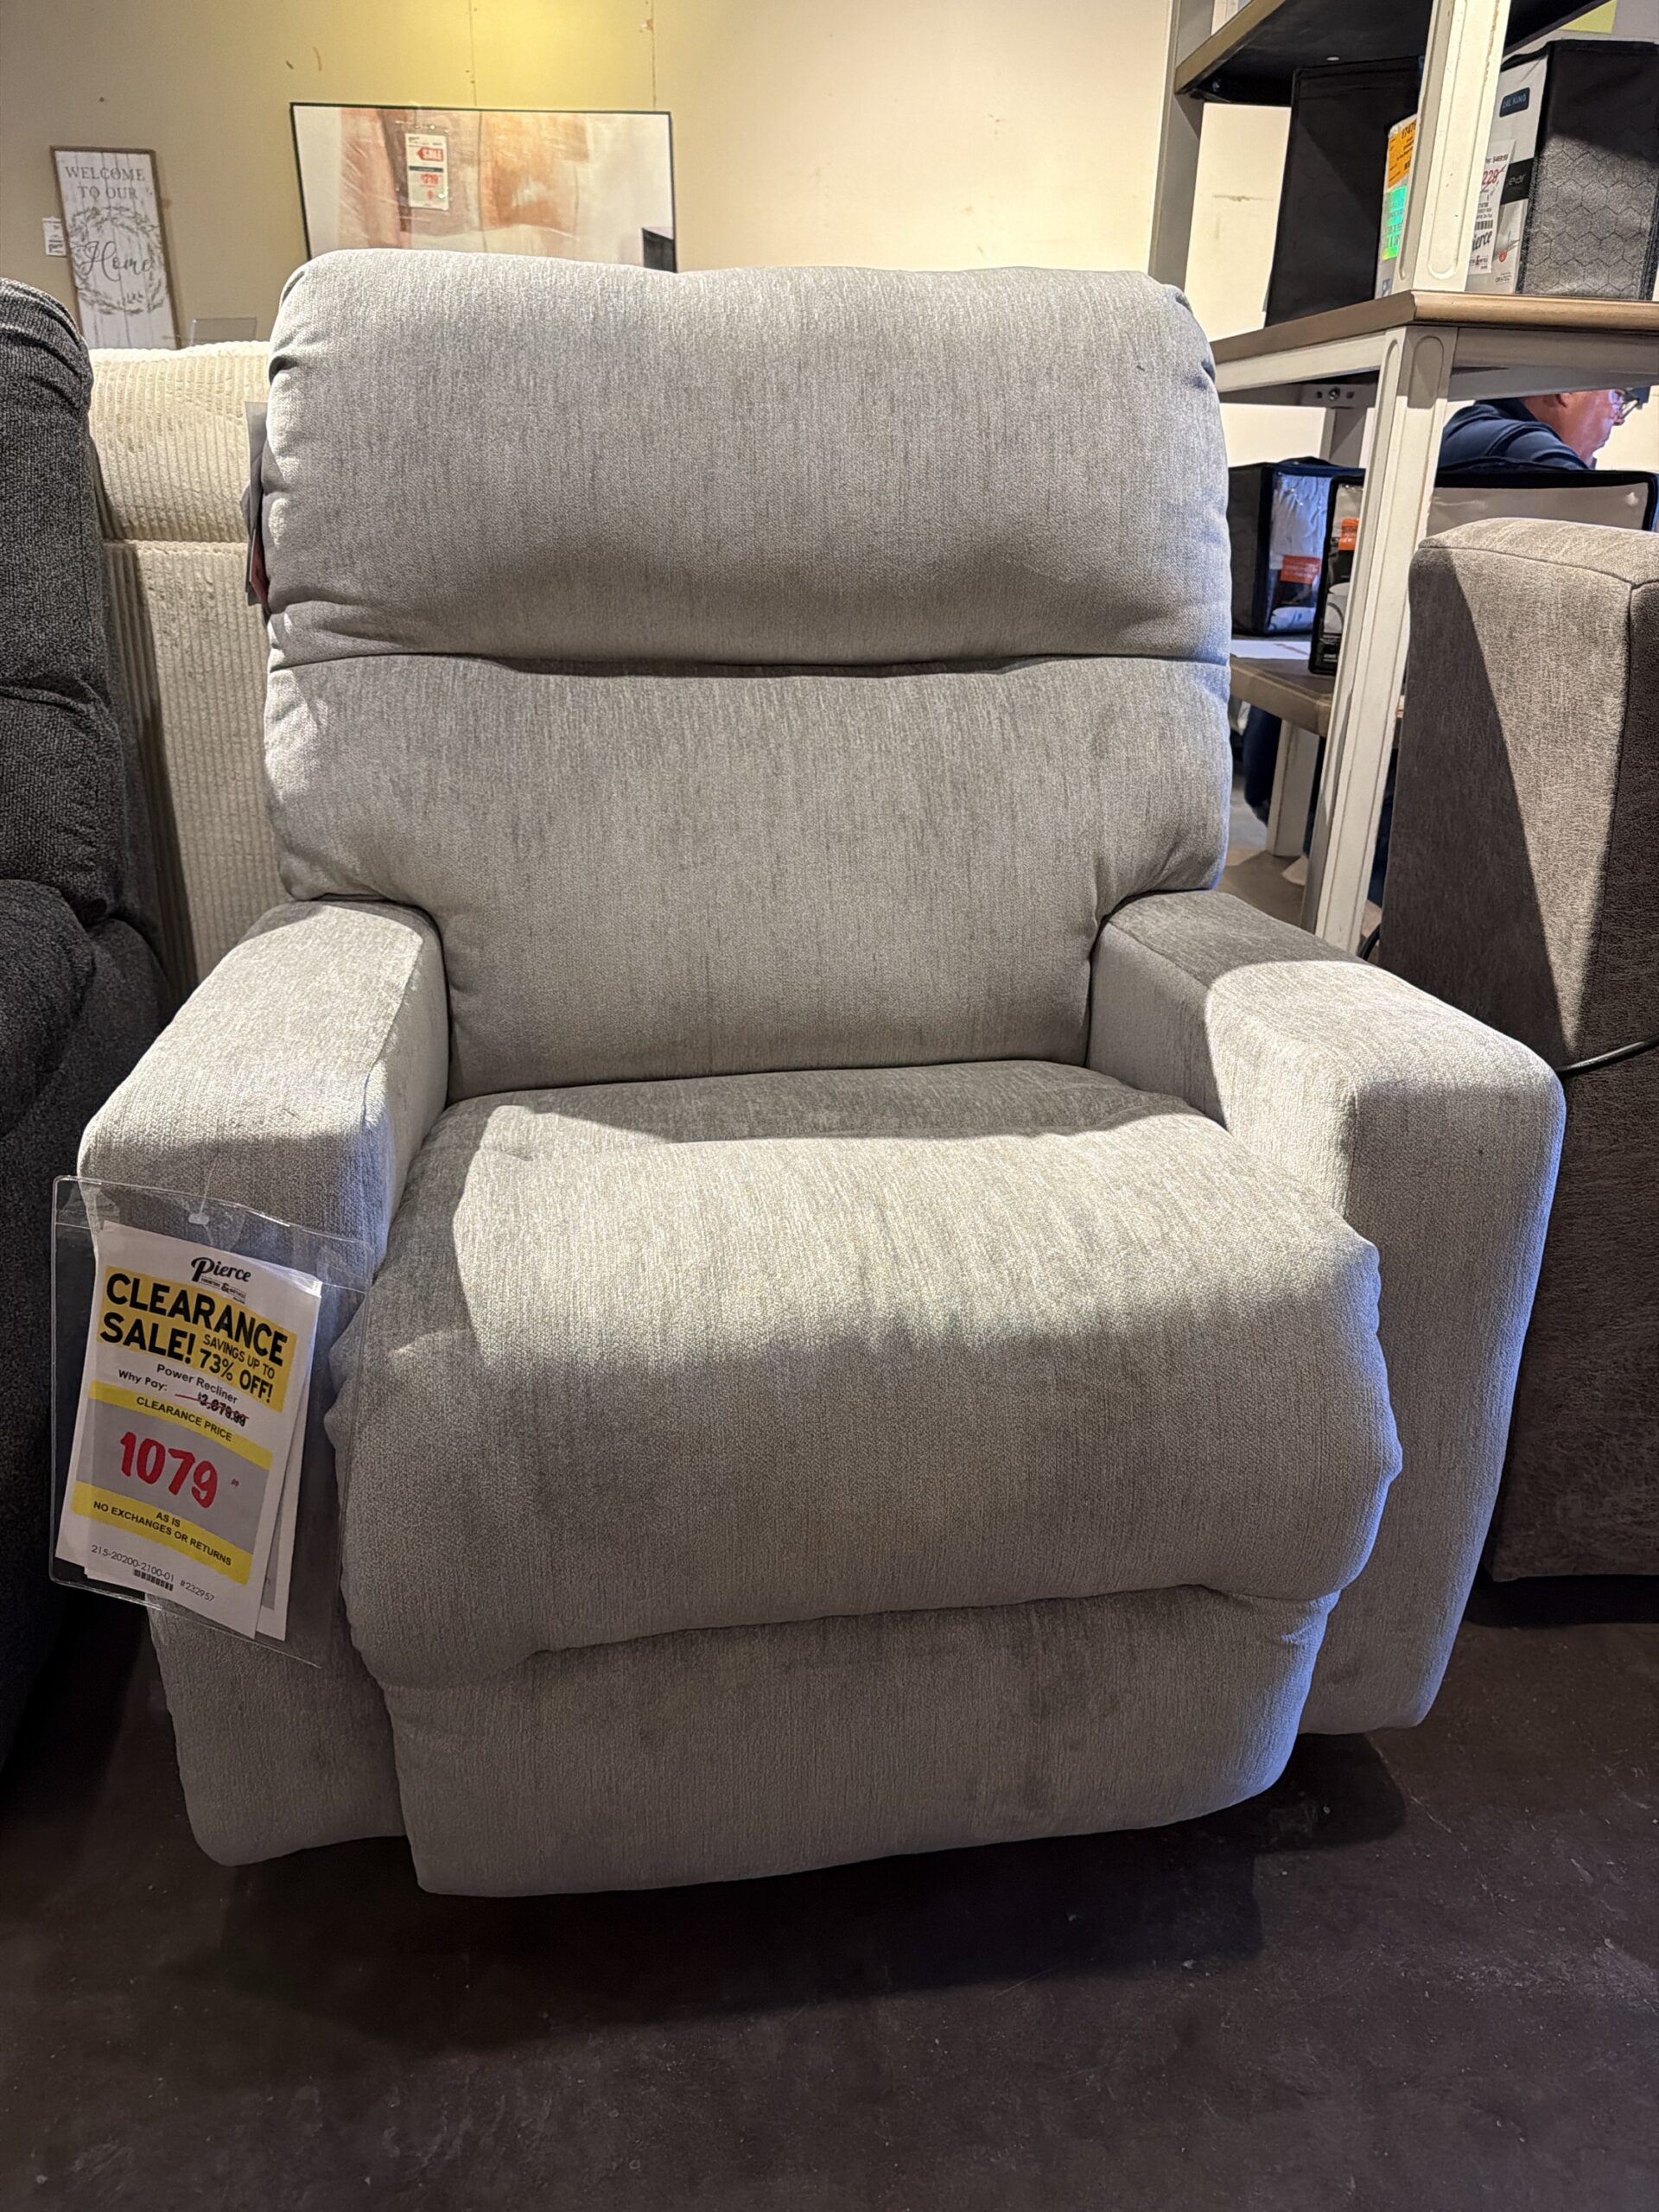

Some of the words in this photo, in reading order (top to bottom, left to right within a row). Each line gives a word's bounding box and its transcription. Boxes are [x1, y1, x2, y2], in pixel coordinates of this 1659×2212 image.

[65, 166, 145, 181] WELCOME
[78, 186, 100, 200] TO
[105, 186, 138, 200] OUR
[81, 240, 152, 282] Home
[1471, 231, 1493, 251] ierce
[191, 1257, 251, 1282] Pierce
[100, 1312, 195, 1364] SALE!
[106, 1273, 289, 1367] CLEARANCE
[200, 1349, 234, 1382] 73%
[239, 1370, 273, 1403] OFF!
[203, 1334, 245, 1363] SAVINGS
[247, 1355, 260, 1370] UP
[263, 1363, 275, 1380] TO
[118, 1369, 142, 1385] Why
[144, 1377, 168, 1392] Pay:
[156, 1363, 194, 1383] Power
[196, 1377, 238, 1404] Recliner
[137, 1396, 202, 1427] CLEARANCE
[204, 1421, 232, 1442] PRICE
[120, 1431, 218, 1508] 1079
[93, 1501, 109, 1512] NO
[111, 1506, 172, 1535] EXCHANGES
[174, 1529, 188, 1543] OR
[190, 1538, 232, 1566] RETURNS
[156, 1511, 169, 1523] AS
[172, 1516, 181, 1528] IS
[90, 1544, 175, 1582] 215-20200-2100-01
[180, 1580, 215, 1603] #232957
